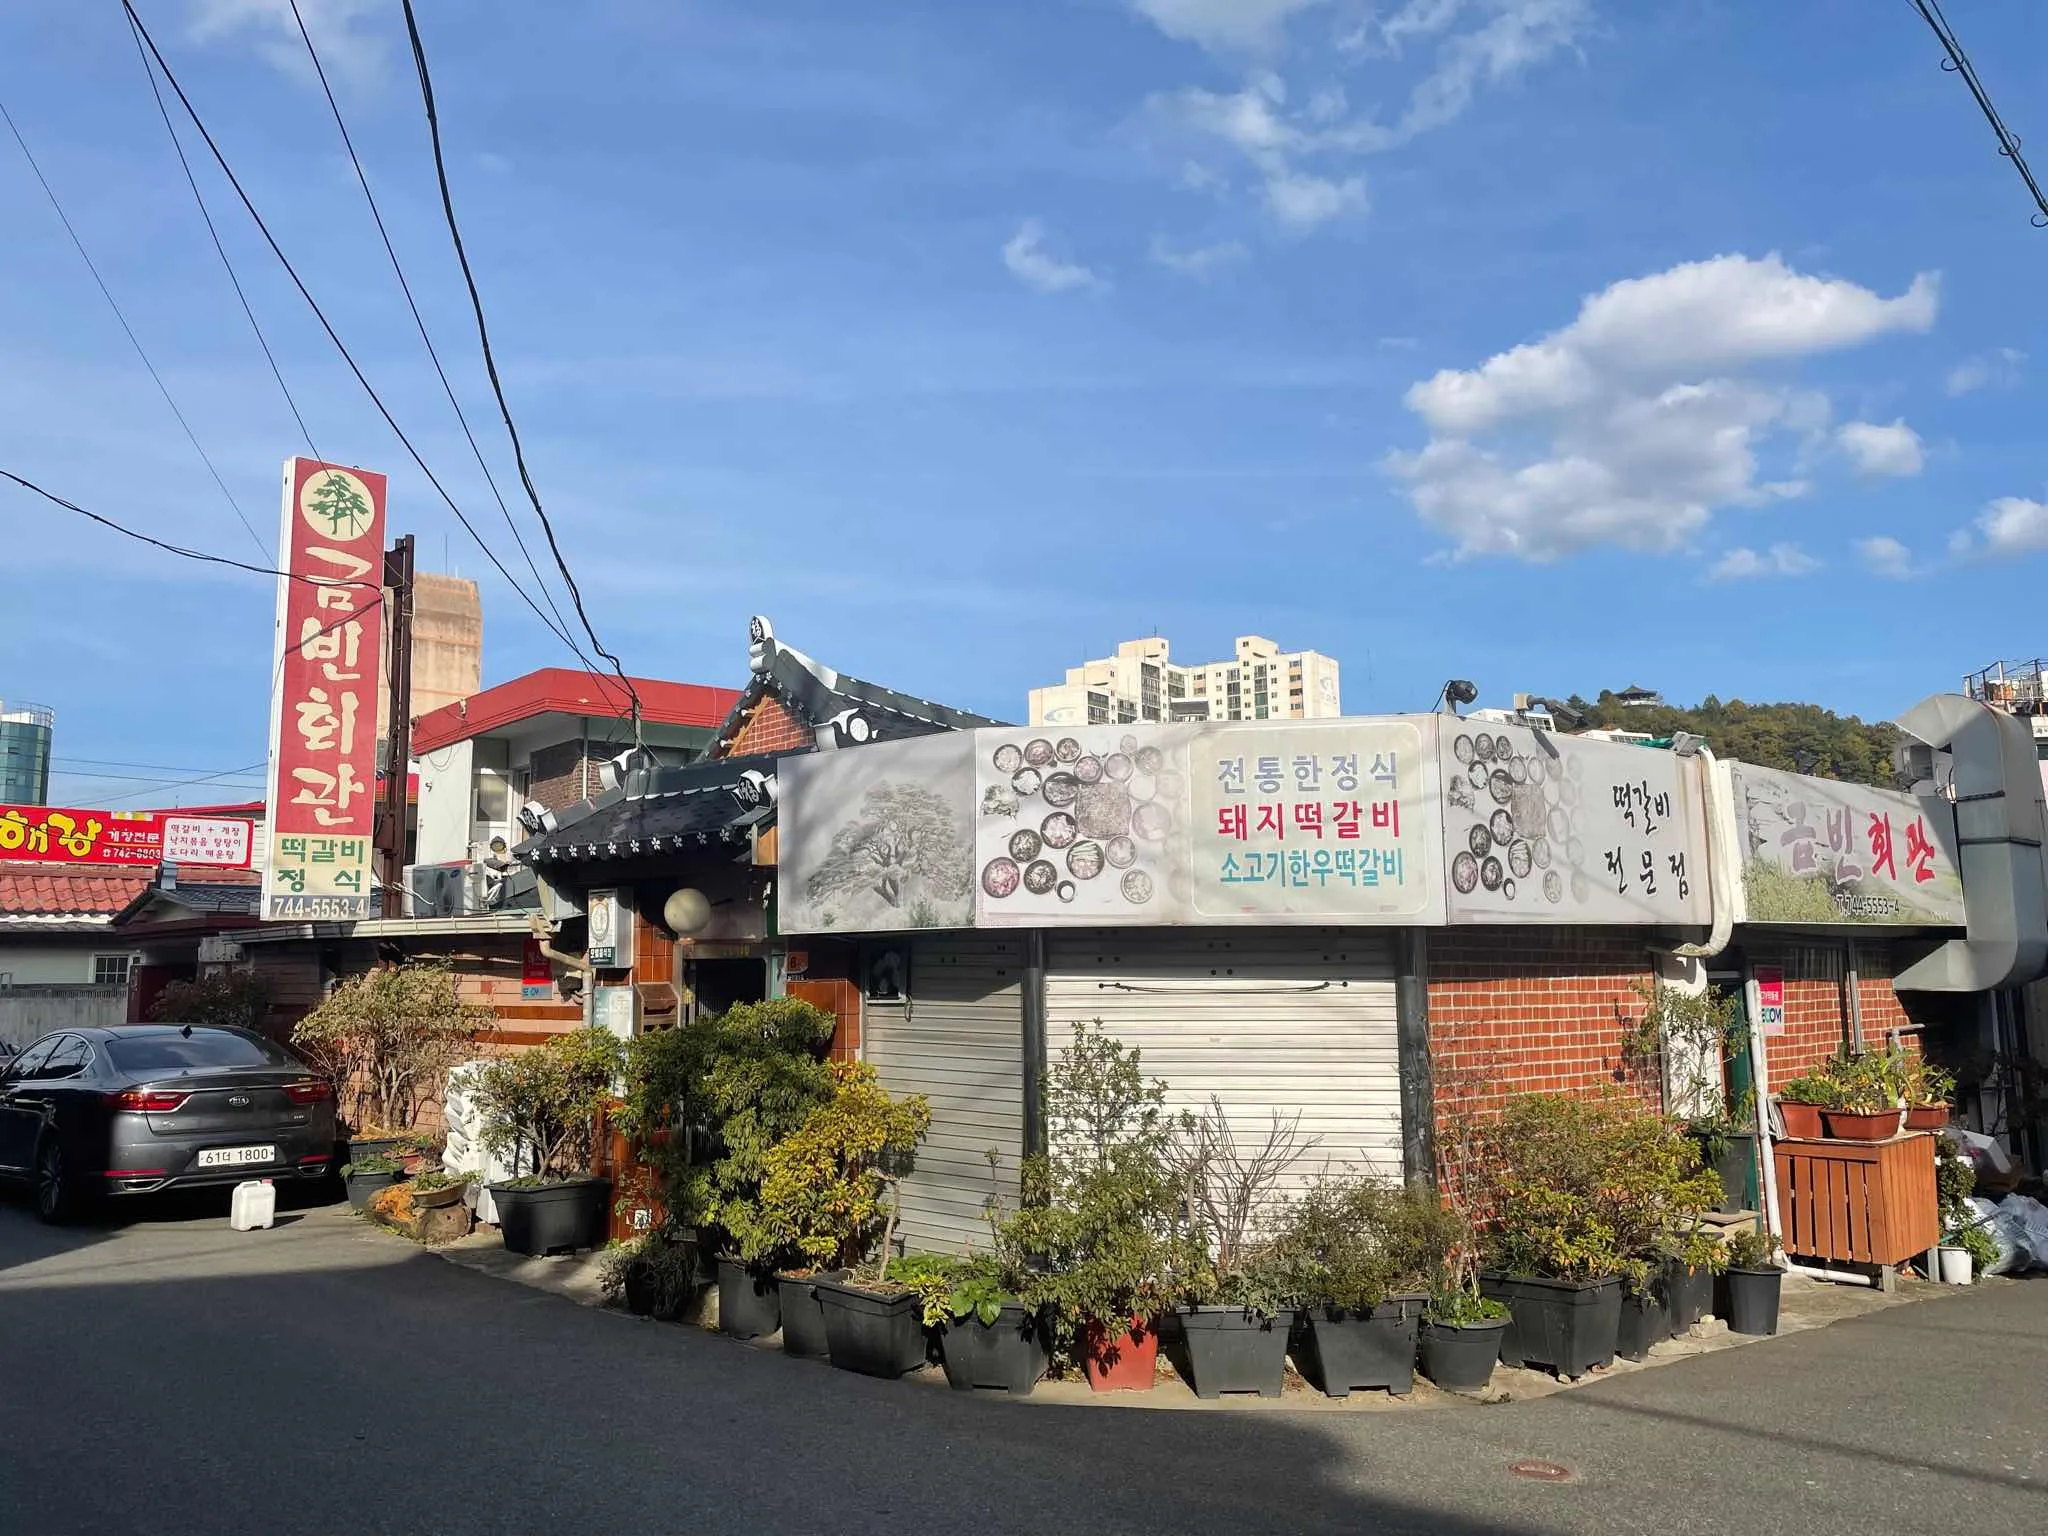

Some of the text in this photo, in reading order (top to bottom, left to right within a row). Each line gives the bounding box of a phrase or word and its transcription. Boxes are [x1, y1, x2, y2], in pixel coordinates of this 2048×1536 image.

[1217, 752, 1398, 794] 전통한정식
[1217, 799, 1400, 841] 돼지떡갈비
[1612, 780, 1670, 836] 떡갈비
[281, 838, 364, 865] 떡갈비
[1219, 848, 1403, 888] 소고기한우떡갈비
[277, 868, 361, 893] 정식
[1604, 846, 1689, 900] 전문점
[275, 898, 365, 919] 744-5553-4
[206, 1148, 268, 1164] 61더 1800
